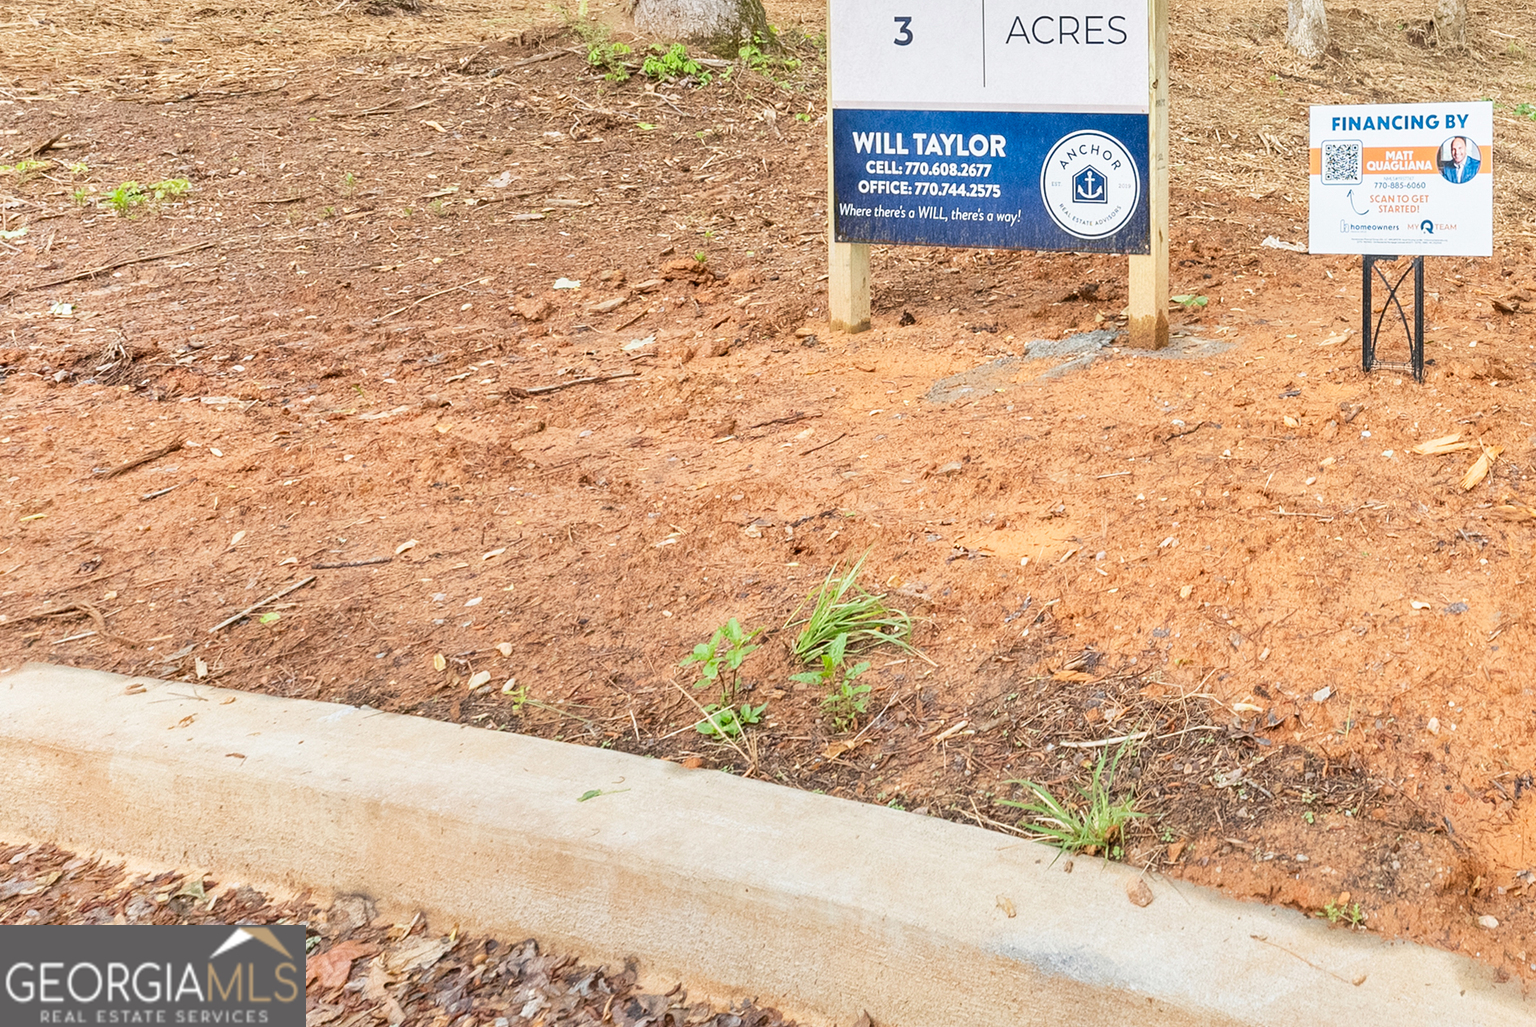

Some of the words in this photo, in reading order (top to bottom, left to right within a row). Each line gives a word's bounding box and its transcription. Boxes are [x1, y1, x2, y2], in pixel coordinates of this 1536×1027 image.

[893, 16, 914, 47] 3
[1005, 15, 1128, 45] ACRES
[1332, 114, 1439, 131] FINANCING
[1445, 114, 1469, 129] BY
[852, 132, 909, 155] WILL
[913, 133, 1006, 157] TAYLOR
[1059, 144, 1122, 170] ANCHOR
[1385, 150, 1414, 161] MATT
[866, 160, 903, 175] CELL:
[905, 162, 992, 177] 770.608.2677
[1366, 160, 1433, 171] QUAGLIANA
[858, 180, 912, 195] OFFICE:
[914, 182, 1001, 198] 770.744.2575
[1374, 181, 1426, 189] 770-885-6060
[1369, 194, 1395, 203] SCAN
[1397, 194, 1410, 203] TO
[1411, 194, 1429, 203] GET
[839, 203, 872, 217] Where
[874, 204, 906, 218] there's
[908, 209, 915, 218] a
[918, 206, 948, 222] WILL,
[951, 207, 984, 221] there's
[986, 212, 993, 222] a
[996, 209, 1021, 227] way!
[1059, 203, 1071, 218] REAL
[1072, 216, 1093, 226] ESTATE
[1378, 204, 1420, 213] STARTED!
